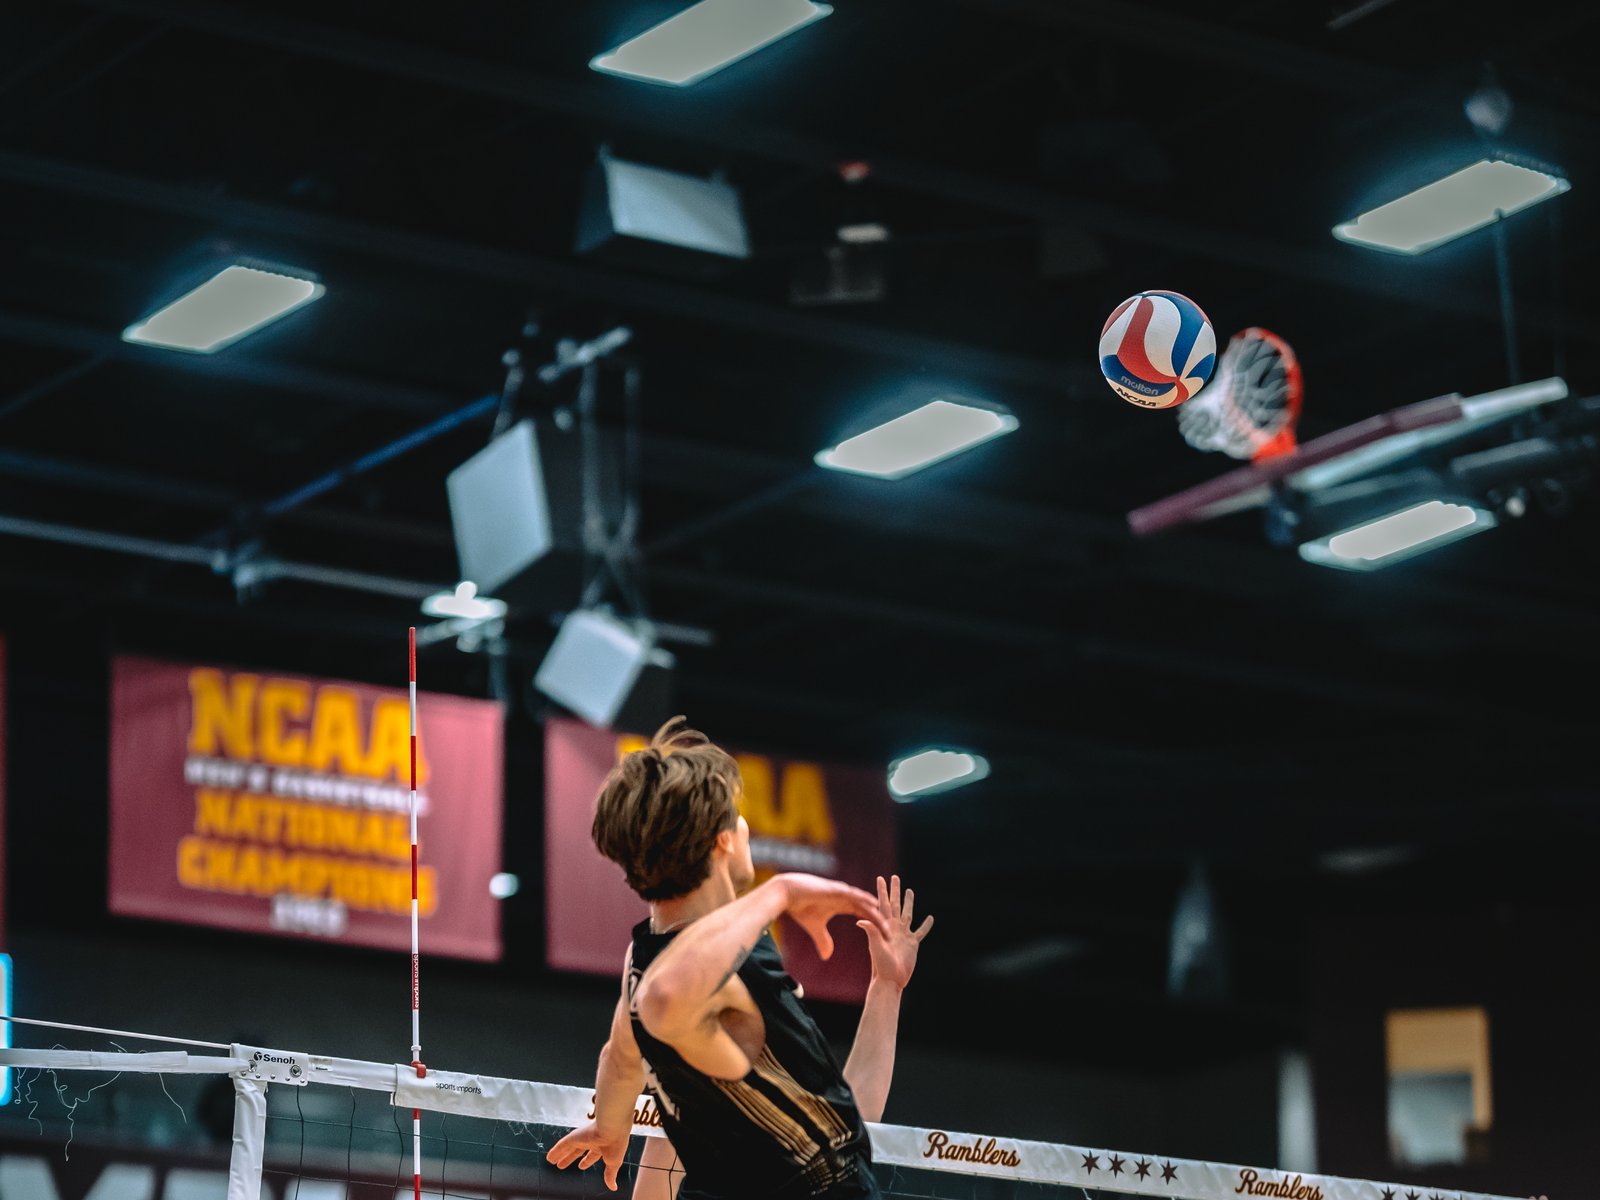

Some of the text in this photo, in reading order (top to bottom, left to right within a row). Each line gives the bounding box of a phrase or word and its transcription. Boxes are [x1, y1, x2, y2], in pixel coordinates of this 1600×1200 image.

[1120, 375, 1159, 396] molten
[1116, 387, 1157, 407] NCAA
[188, 669, 428, 784] NCAA
[263, 1053, 296, 1065] Senoh
[923, 1132, 1021, 1167] Ramblers
